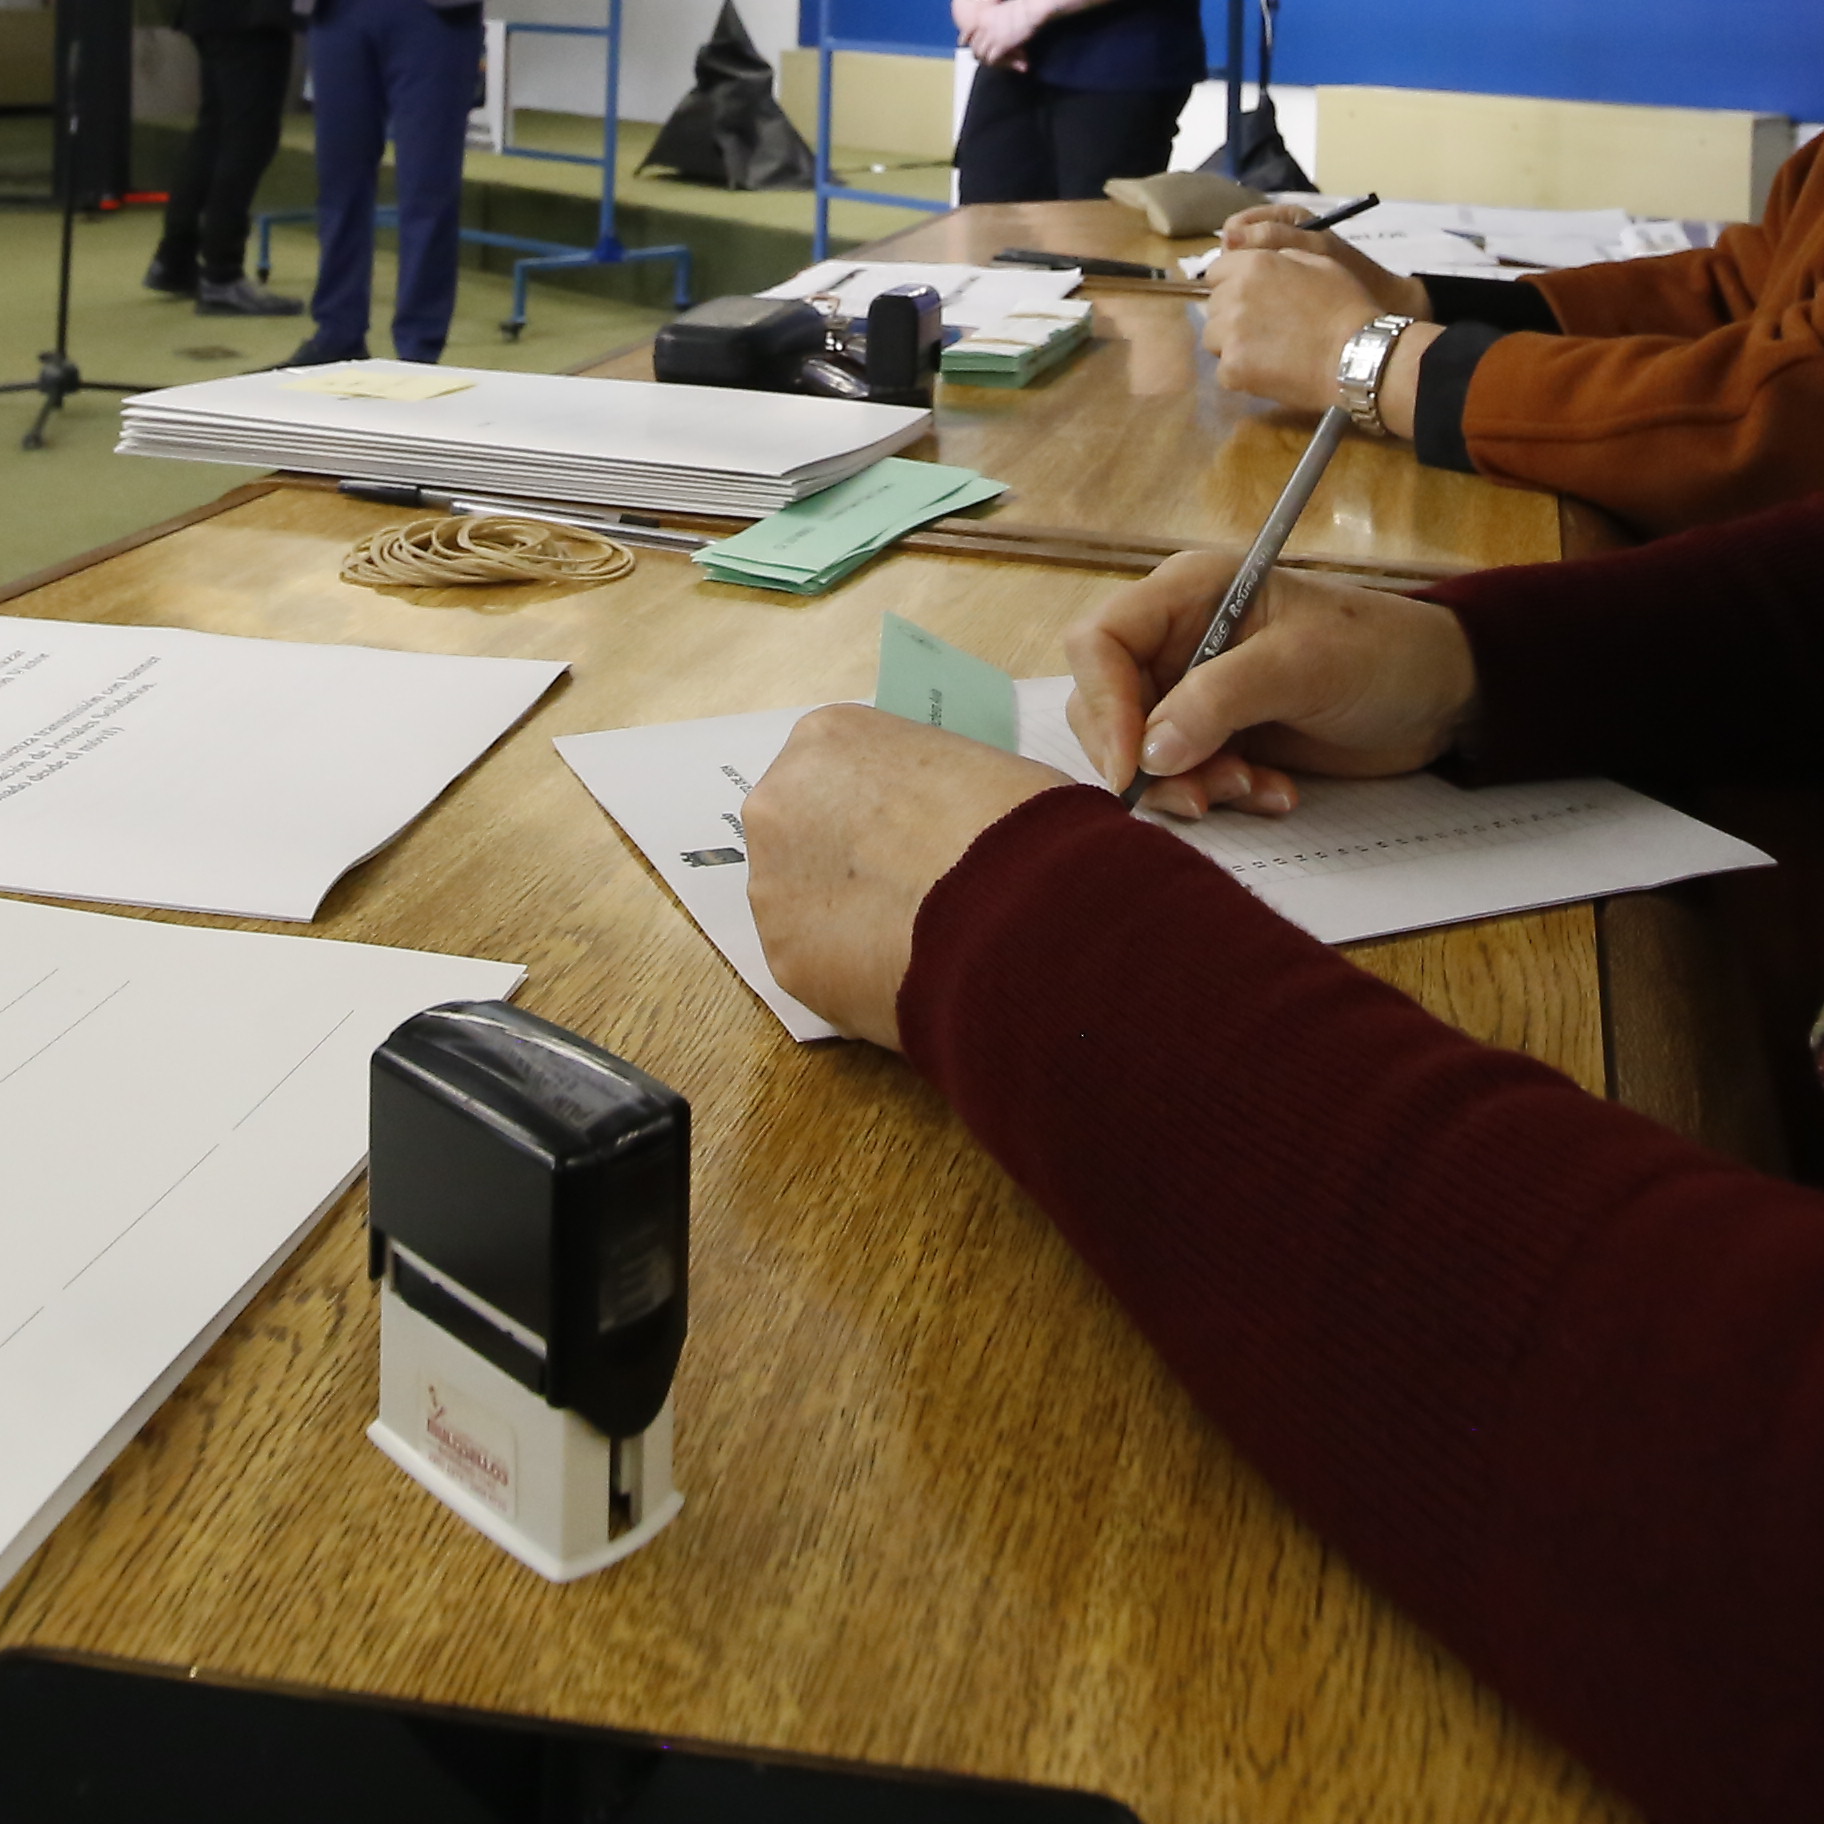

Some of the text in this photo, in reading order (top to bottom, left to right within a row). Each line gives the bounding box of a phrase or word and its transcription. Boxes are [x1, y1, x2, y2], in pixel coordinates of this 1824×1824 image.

[1228, 569, 1259, 618] Round
[44, 719, 101, 750] Jornales
[28, 759, 71, 783] desde
